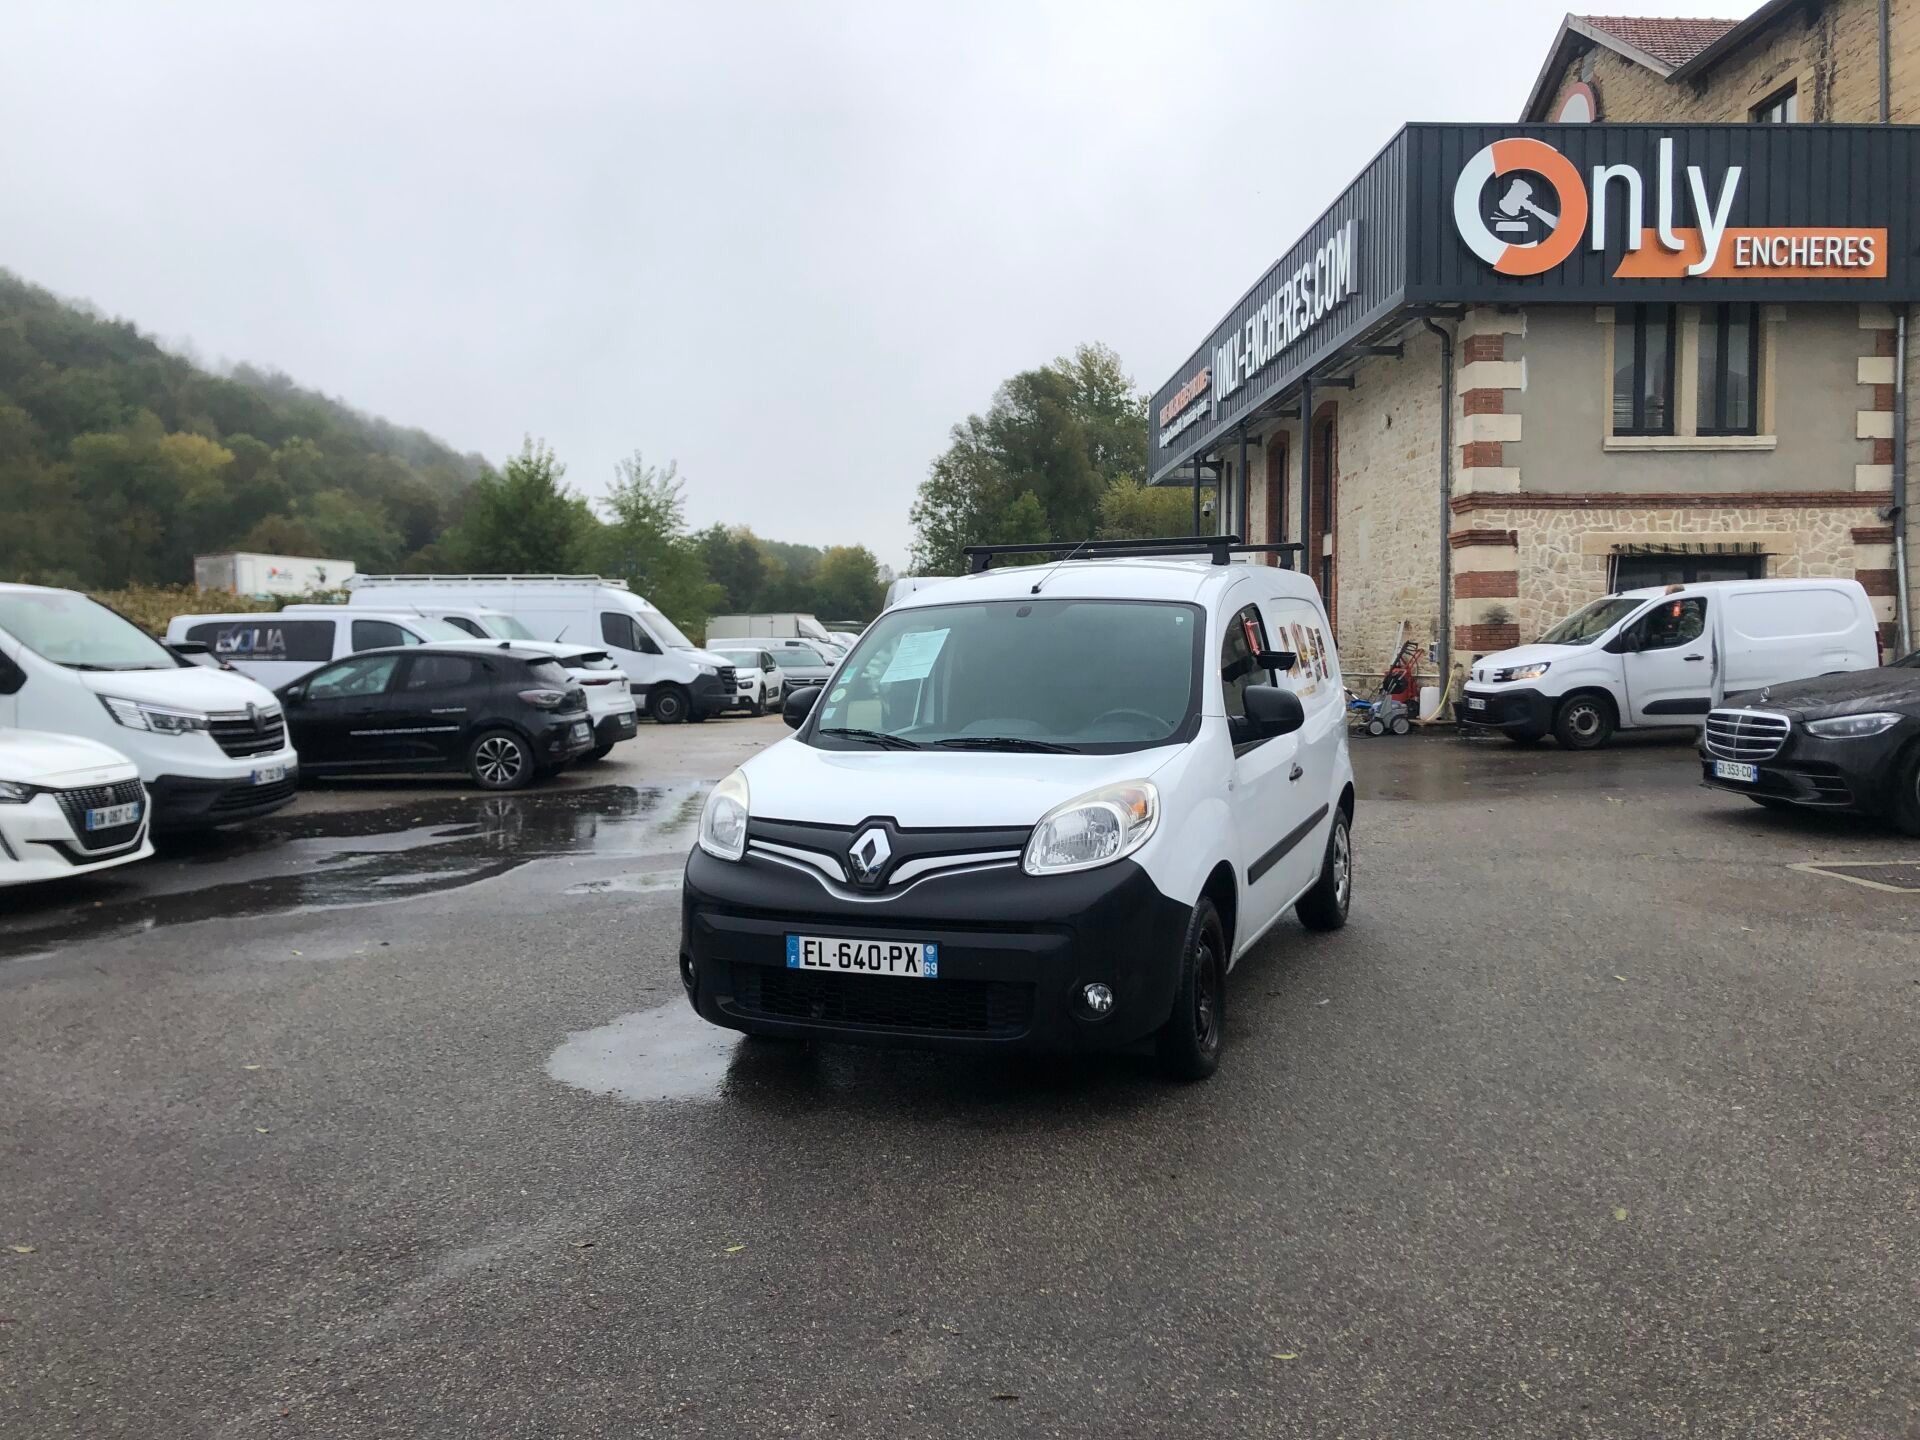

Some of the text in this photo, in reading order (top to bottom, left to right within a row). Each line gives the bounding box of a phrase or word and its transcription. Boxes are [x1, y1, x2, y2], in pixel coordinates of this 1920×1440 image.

[1454, 137, 1742, 276] Only
[1736, 236, 1876, 267] ENCHERES
[1217, 219, 1355, 401] ONLY-ENCHERES.COM
[803, 940, 918, 974] EL-640-PX
[924, 961, 938, 976] 69
